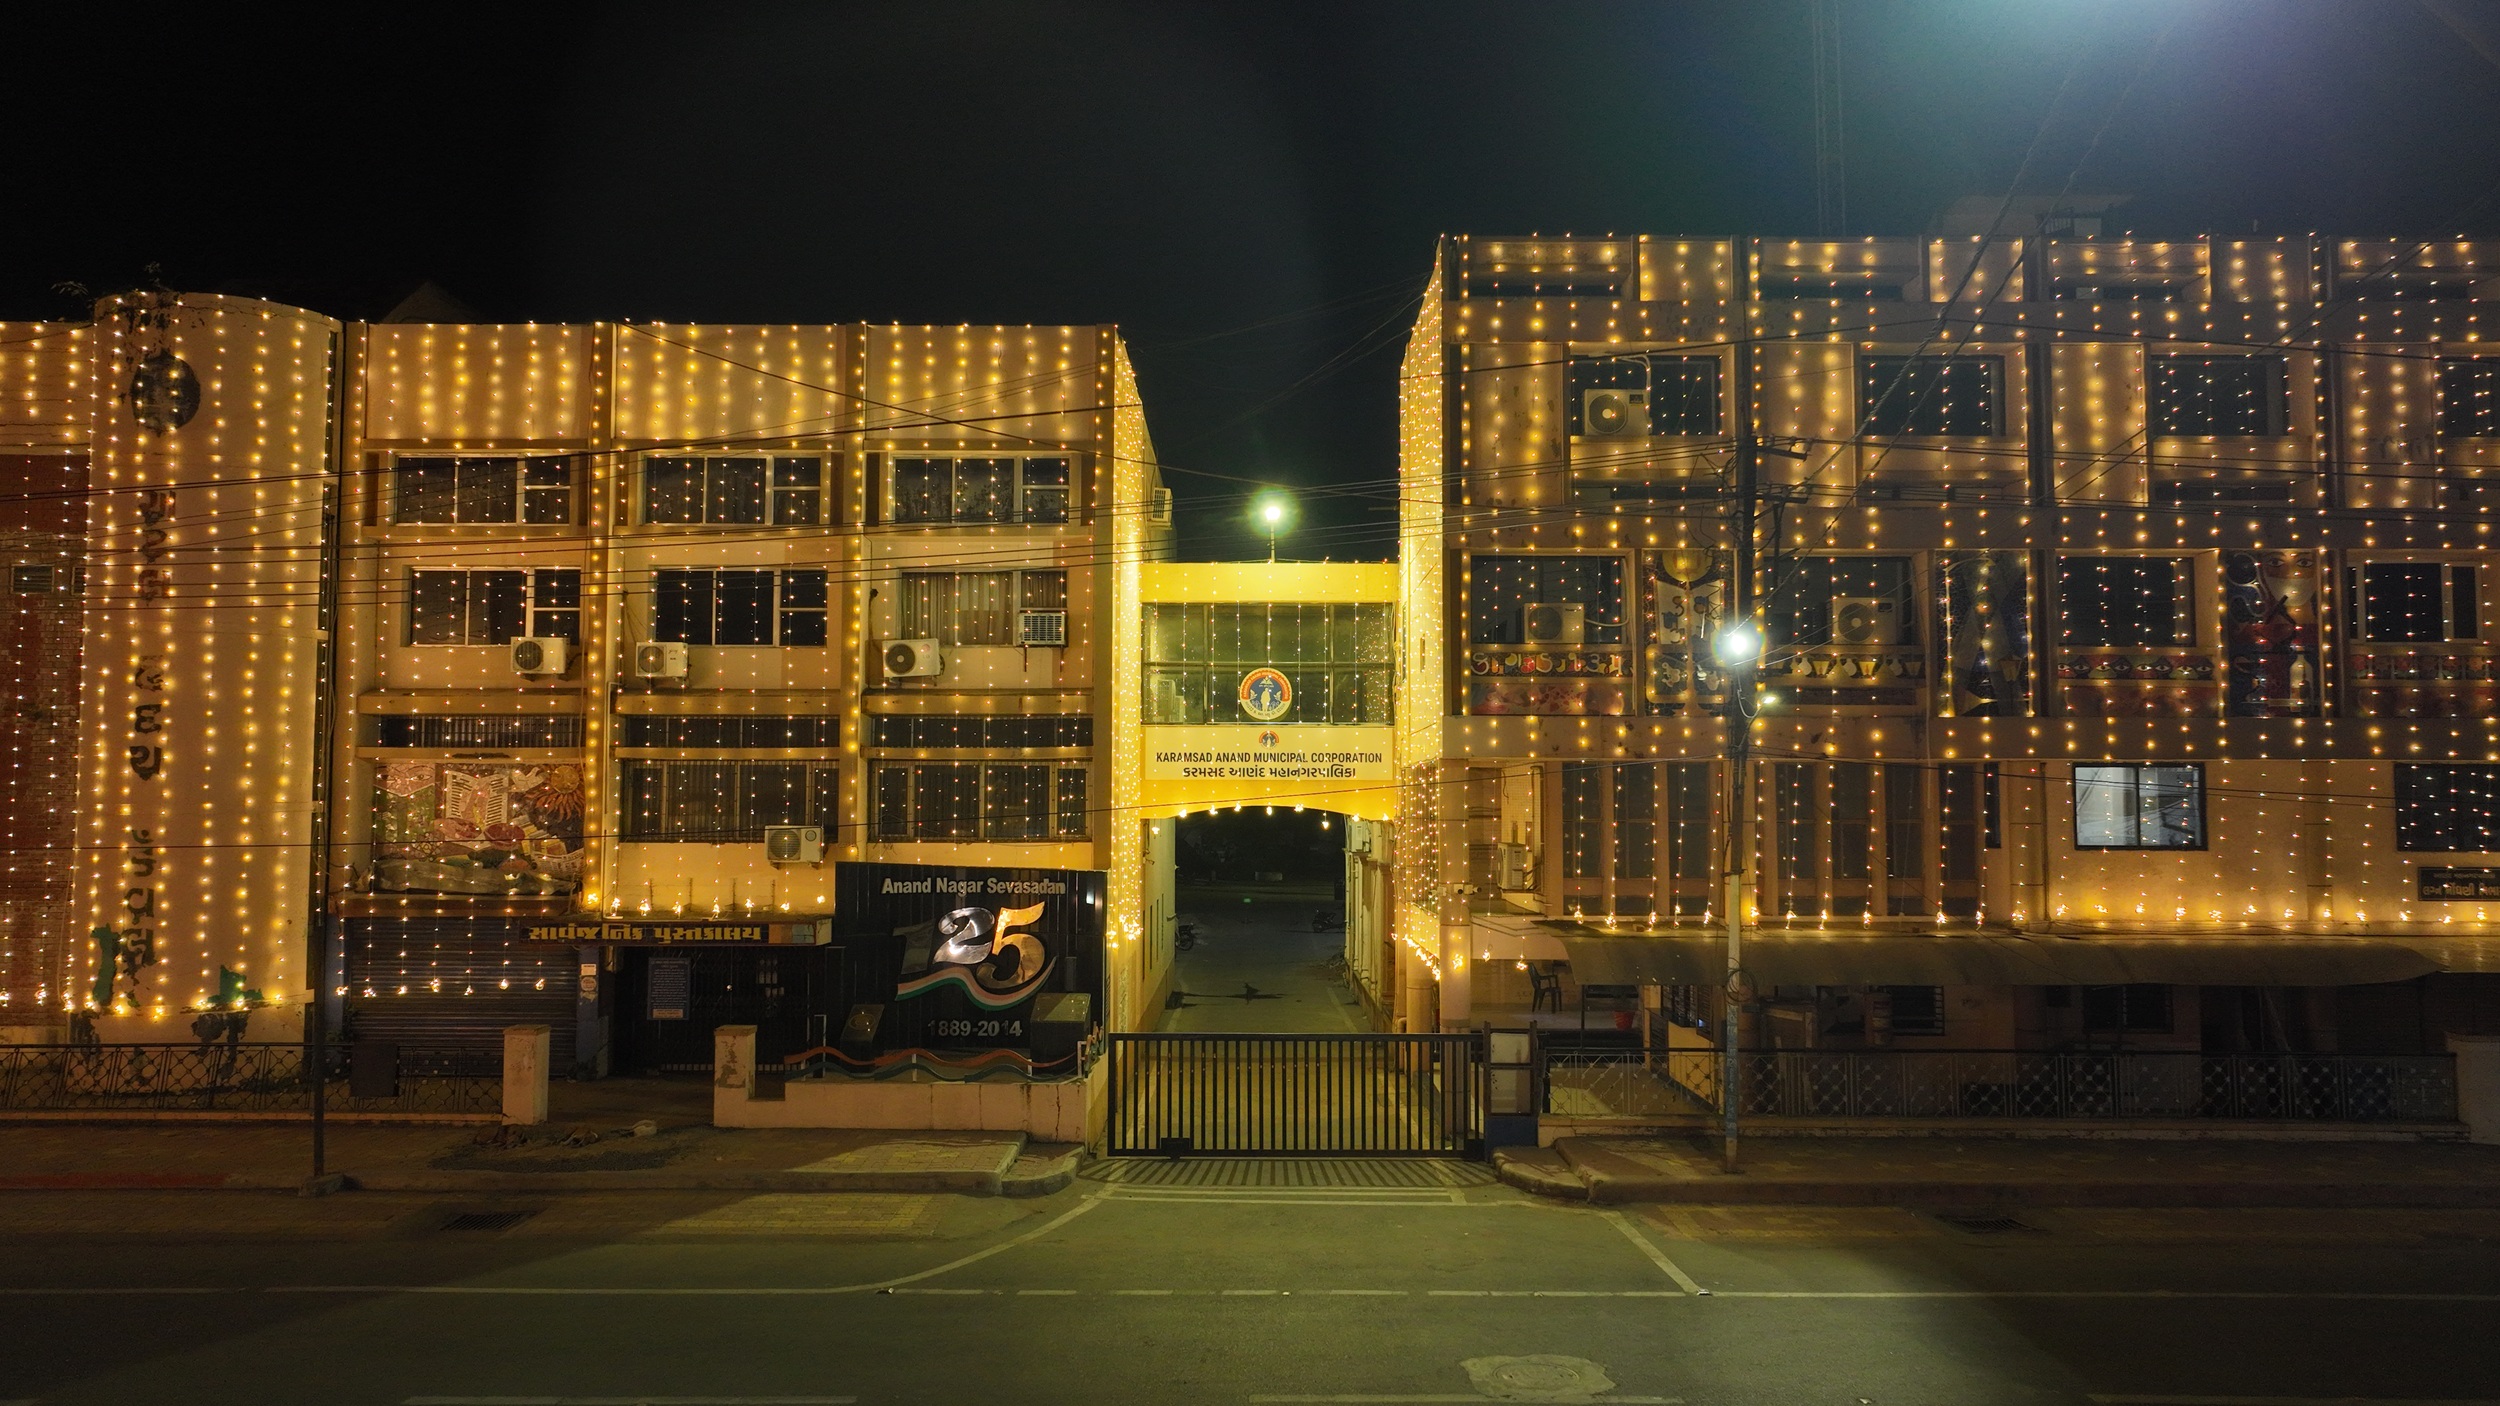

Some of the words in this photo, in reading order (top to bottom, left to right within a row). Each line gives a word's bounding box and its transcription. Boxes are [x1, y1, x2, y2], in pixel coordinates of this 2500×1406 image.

[1156, 752, 1213, 763] KARAMSAD
[1215, 752, 1251, 763] ANAND
[1253, 752, 1308, 763] MUNICIPAL
[1311, 752, 1382, 763] CORPORATION
[1183, 767, 1225, 778] કરમસદ
[1228, 764, 1266, 778] આણંદ
[1269, 764, 1356, 778] મહાનગરપાલિકા
[881, 877, 932, 894] Anand
[936, 877, 984, 897] Nagar
[987, 877, 1066, 895] Sevasadan
[927, 1019, 1023, 1037] 1889-2014
